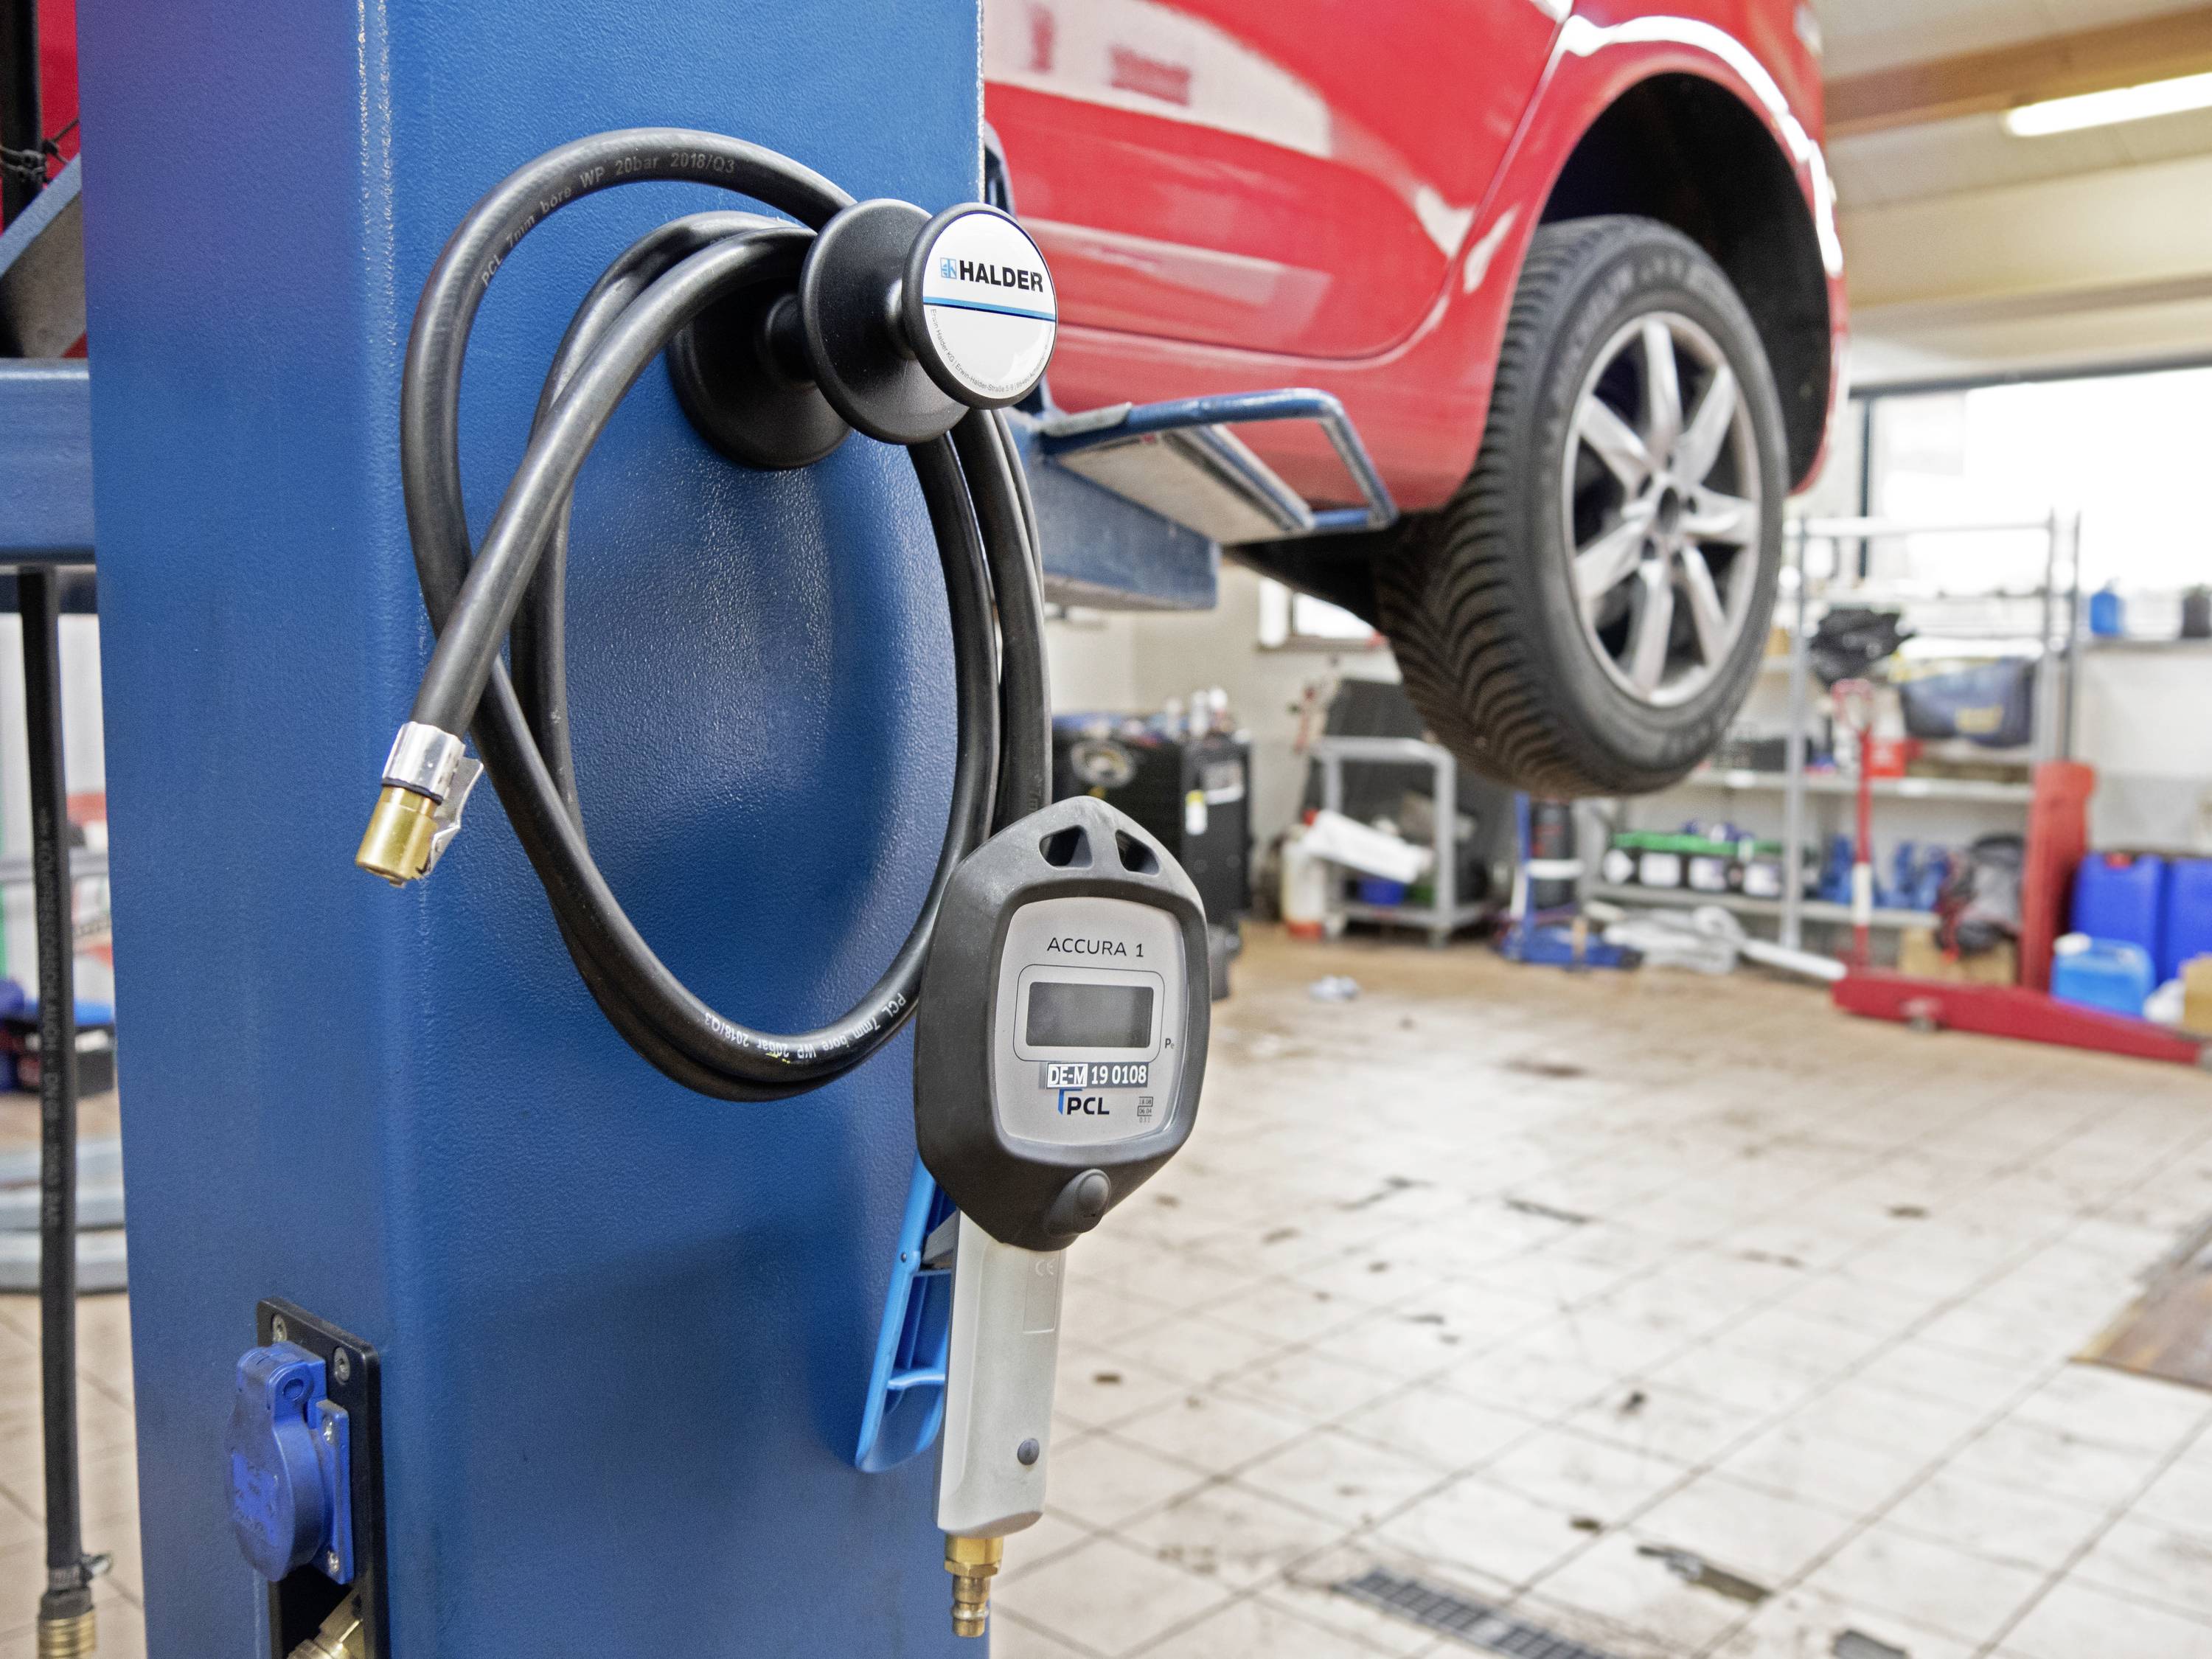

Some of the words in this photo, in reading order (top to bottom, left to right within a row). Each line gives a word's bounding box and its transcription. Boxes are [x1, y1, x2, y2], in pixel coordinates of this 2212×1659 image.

[481, 254, 503, 286] PCL
[507, 214, 536, 248] 7mm
[540, 186, 572, 215] bore
[580, 166, 606, 189] WP
[614, 156, 658, 176] 20bar
[669, 152, 736, 174] 2018/Q3
[959, 260, 1043, 293] HALDER
[936, 330, 949, 353] Halder
[946, 352, 956, 363] KG
[1047, 937, 1127, 956] ACCURA
[1135, 944, 1144, 957] 1
[881, 993, 906, 1019] PCL
[703, 1012, 749, 1048] 2018/Q3
[853, 1017, 880, 1040] 7mm
[757, 1037, 790, 1059] 20bar
[797, 1043, 817, 1060] WP
[821, 1034, 850, 1051] bore
[1048, 1065, 1087, 1085] DE-M
[1091, 1065, 1108, 1085] 19
[1111, 1065, 1147, 1085] 0108
[1066, 1096, 1110, 1115] PCL
